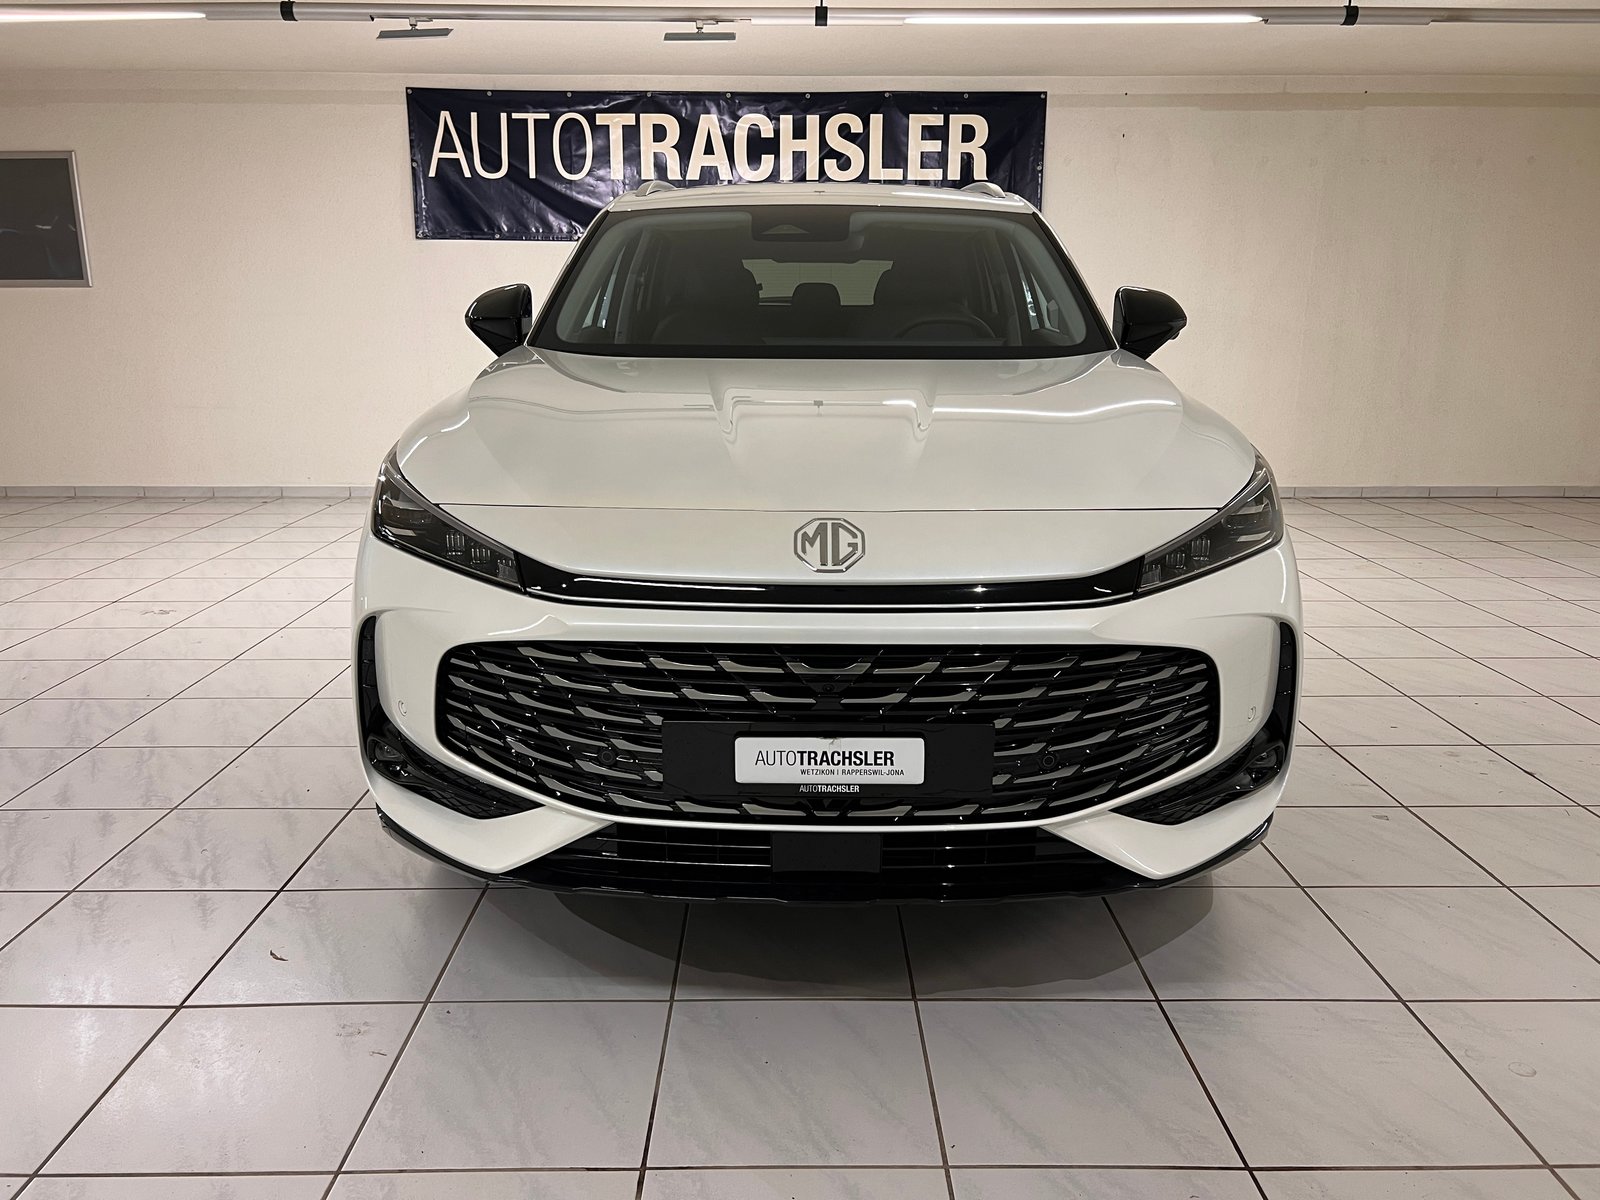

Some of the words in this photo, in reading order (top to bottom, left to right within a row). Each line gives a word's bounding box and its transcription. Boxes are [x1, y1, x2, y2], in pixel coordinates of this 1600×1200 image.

[428, 110, 989, 182] AUTOTRACHSLER
[800, 521, 859, 567] MG
[754, 750, 895, 767] AUTOTRACHSLER
[800, 768, 835, 776] WETZIKON
[841, 768, 905, 776] RAPPERSWIL-JONA
[799, 784, 860, 793] AUTOTRACHSLER
